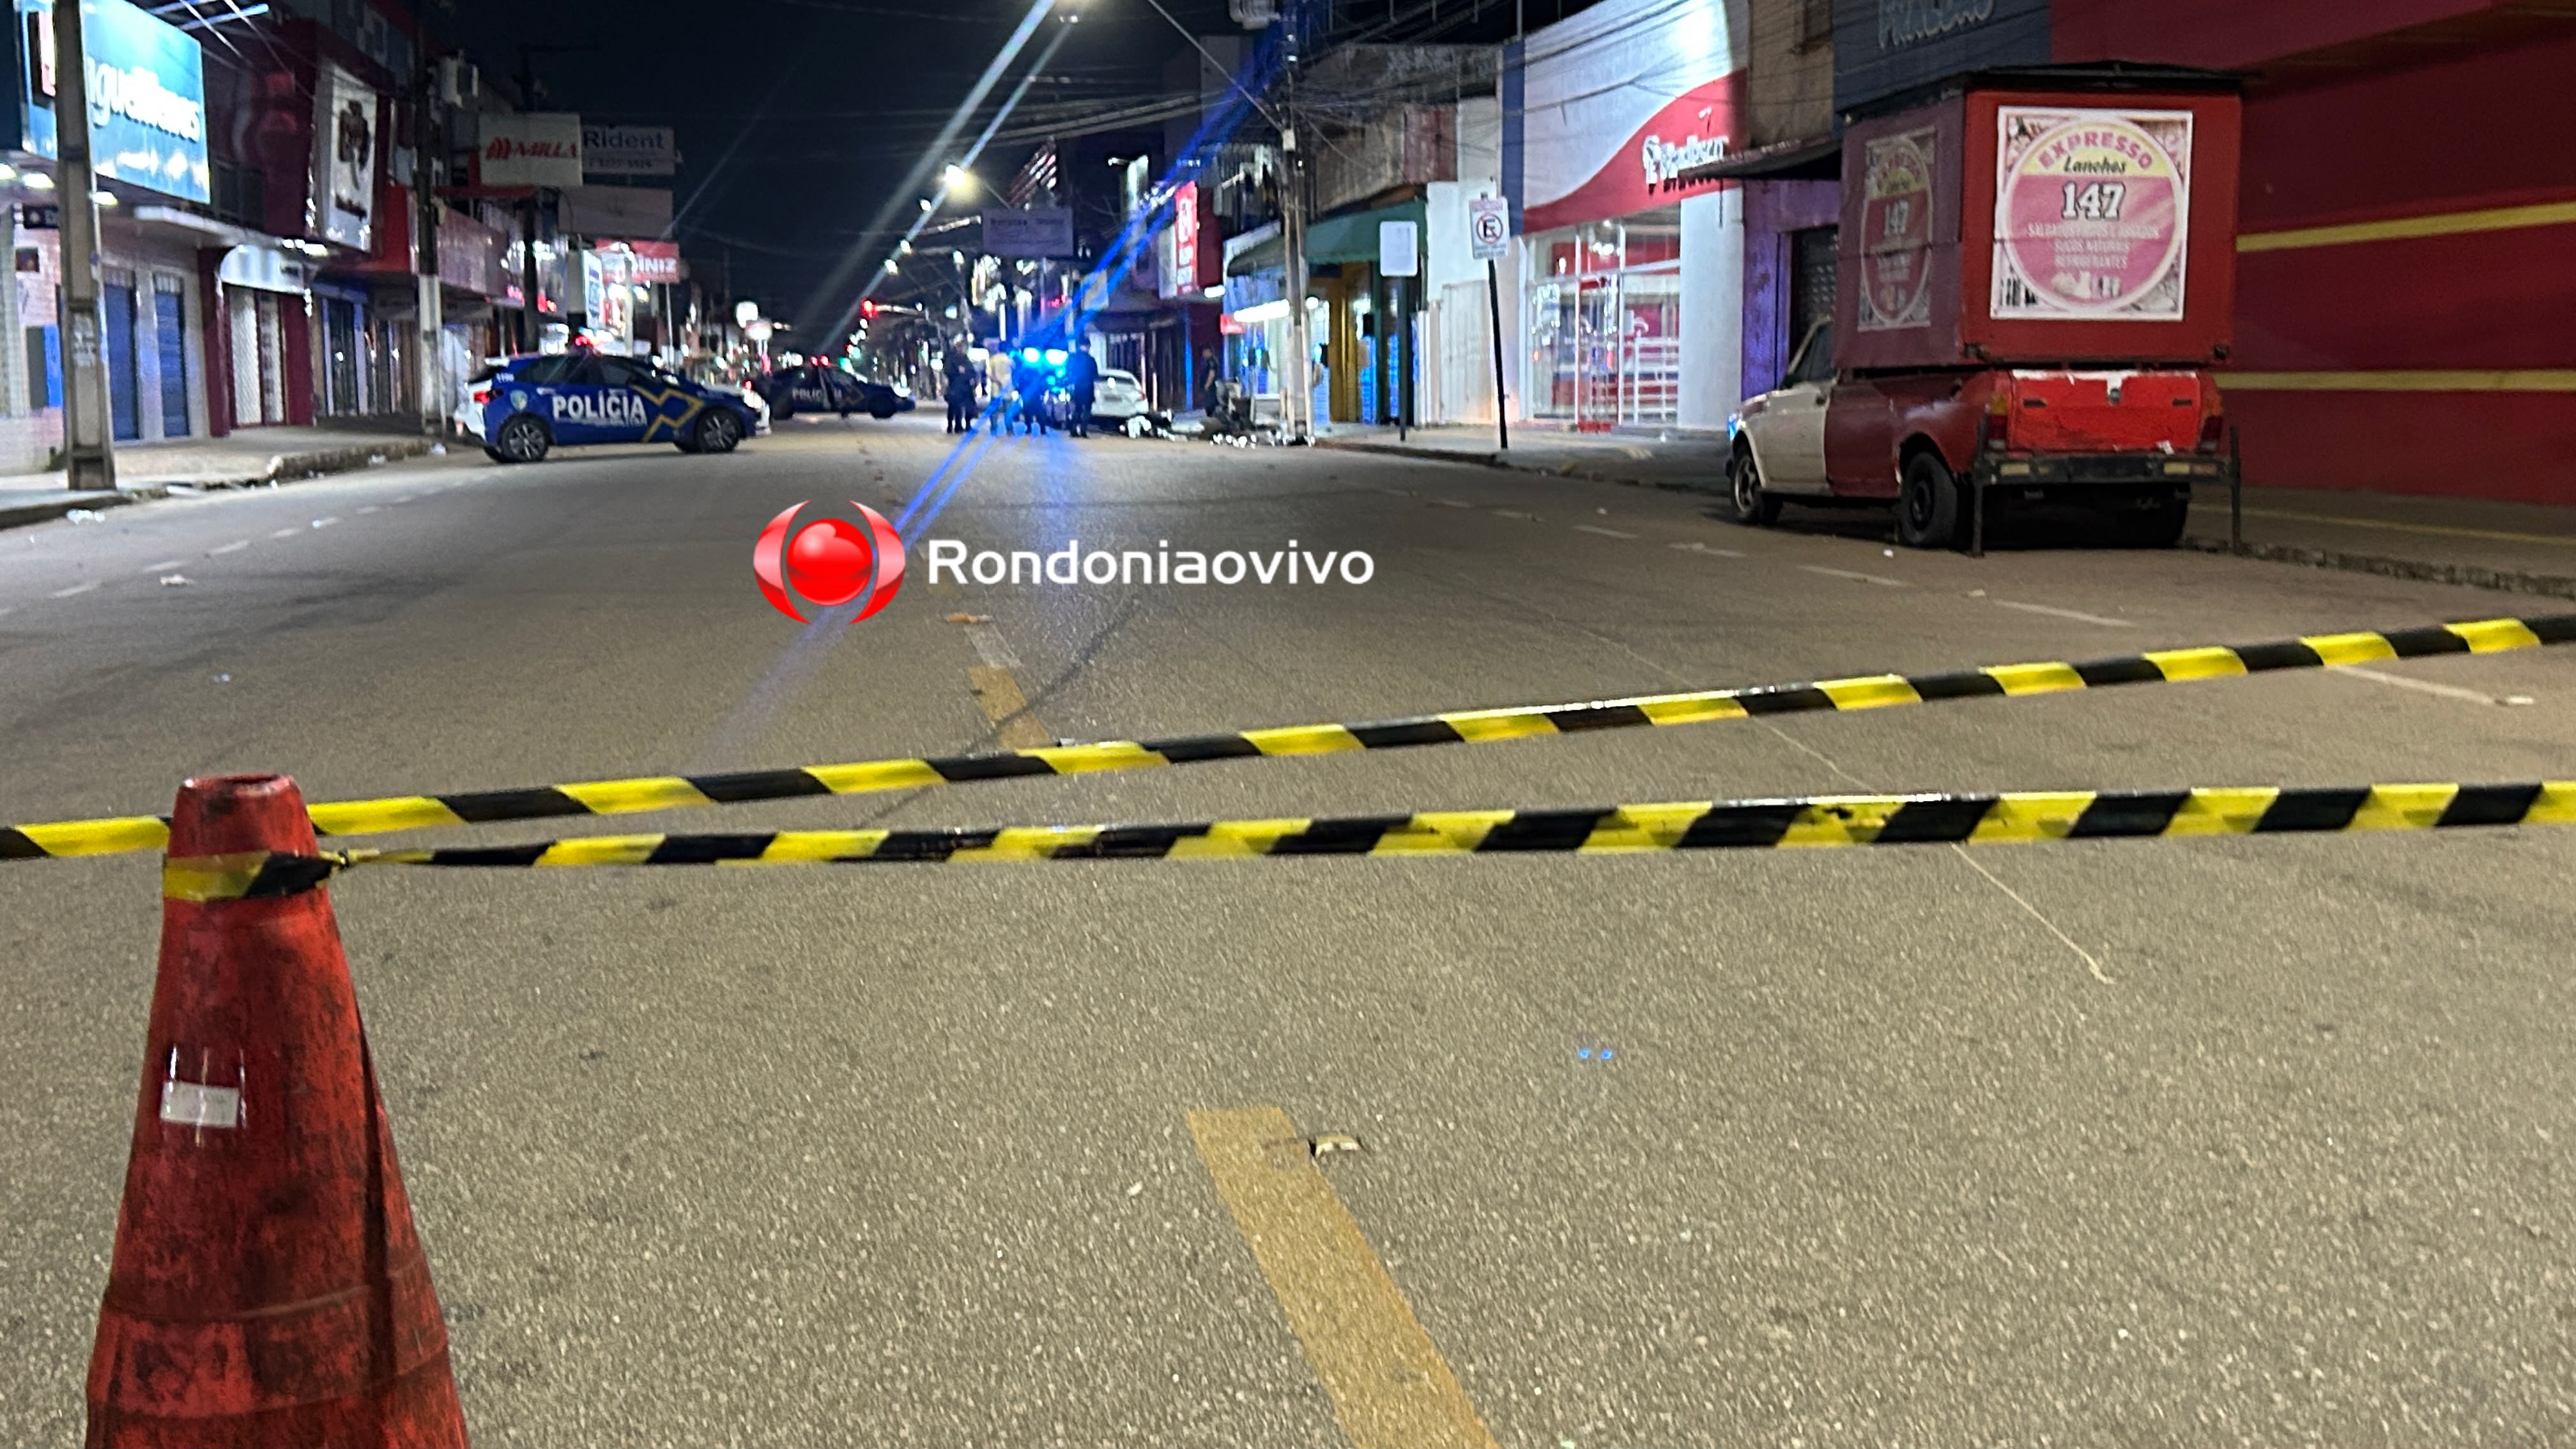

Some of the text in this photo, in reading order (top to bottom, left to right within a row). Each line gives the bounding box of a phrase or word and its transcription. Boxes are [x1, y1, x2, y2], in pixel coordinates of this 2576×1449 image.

[2038, 132, 2152, 169] EXPRESSO
[2064, 156, 2126, 173] Lanches
[2062, 180, 2126, 221] 147
[552, 390, 647, 422] POLÍCIA
